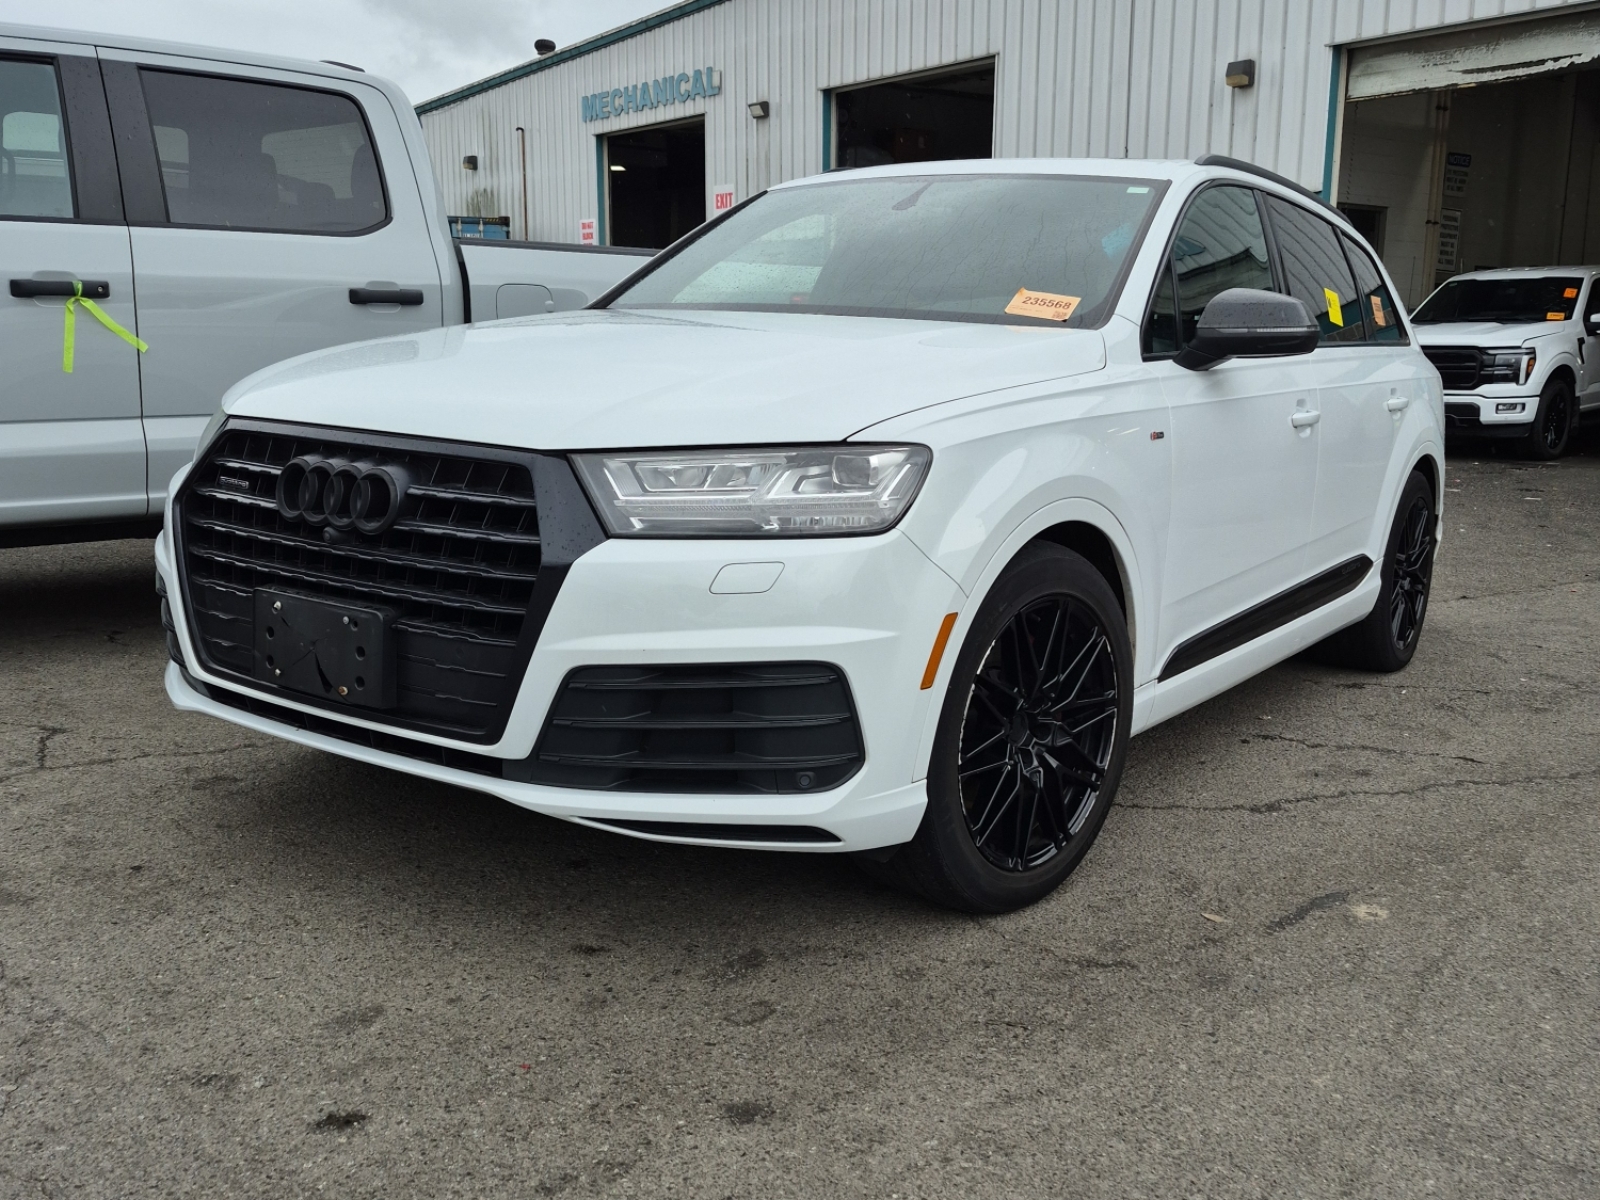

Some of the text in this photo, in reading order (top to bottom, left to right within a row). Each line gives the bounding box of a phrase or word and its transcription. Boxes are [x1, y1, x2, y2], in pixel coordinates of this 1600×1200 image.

[581, 66, 720, 123] MECHANICAL
[715, 192, 733, 210] EXIT
[1021, 296, 1072, 310] 235568
